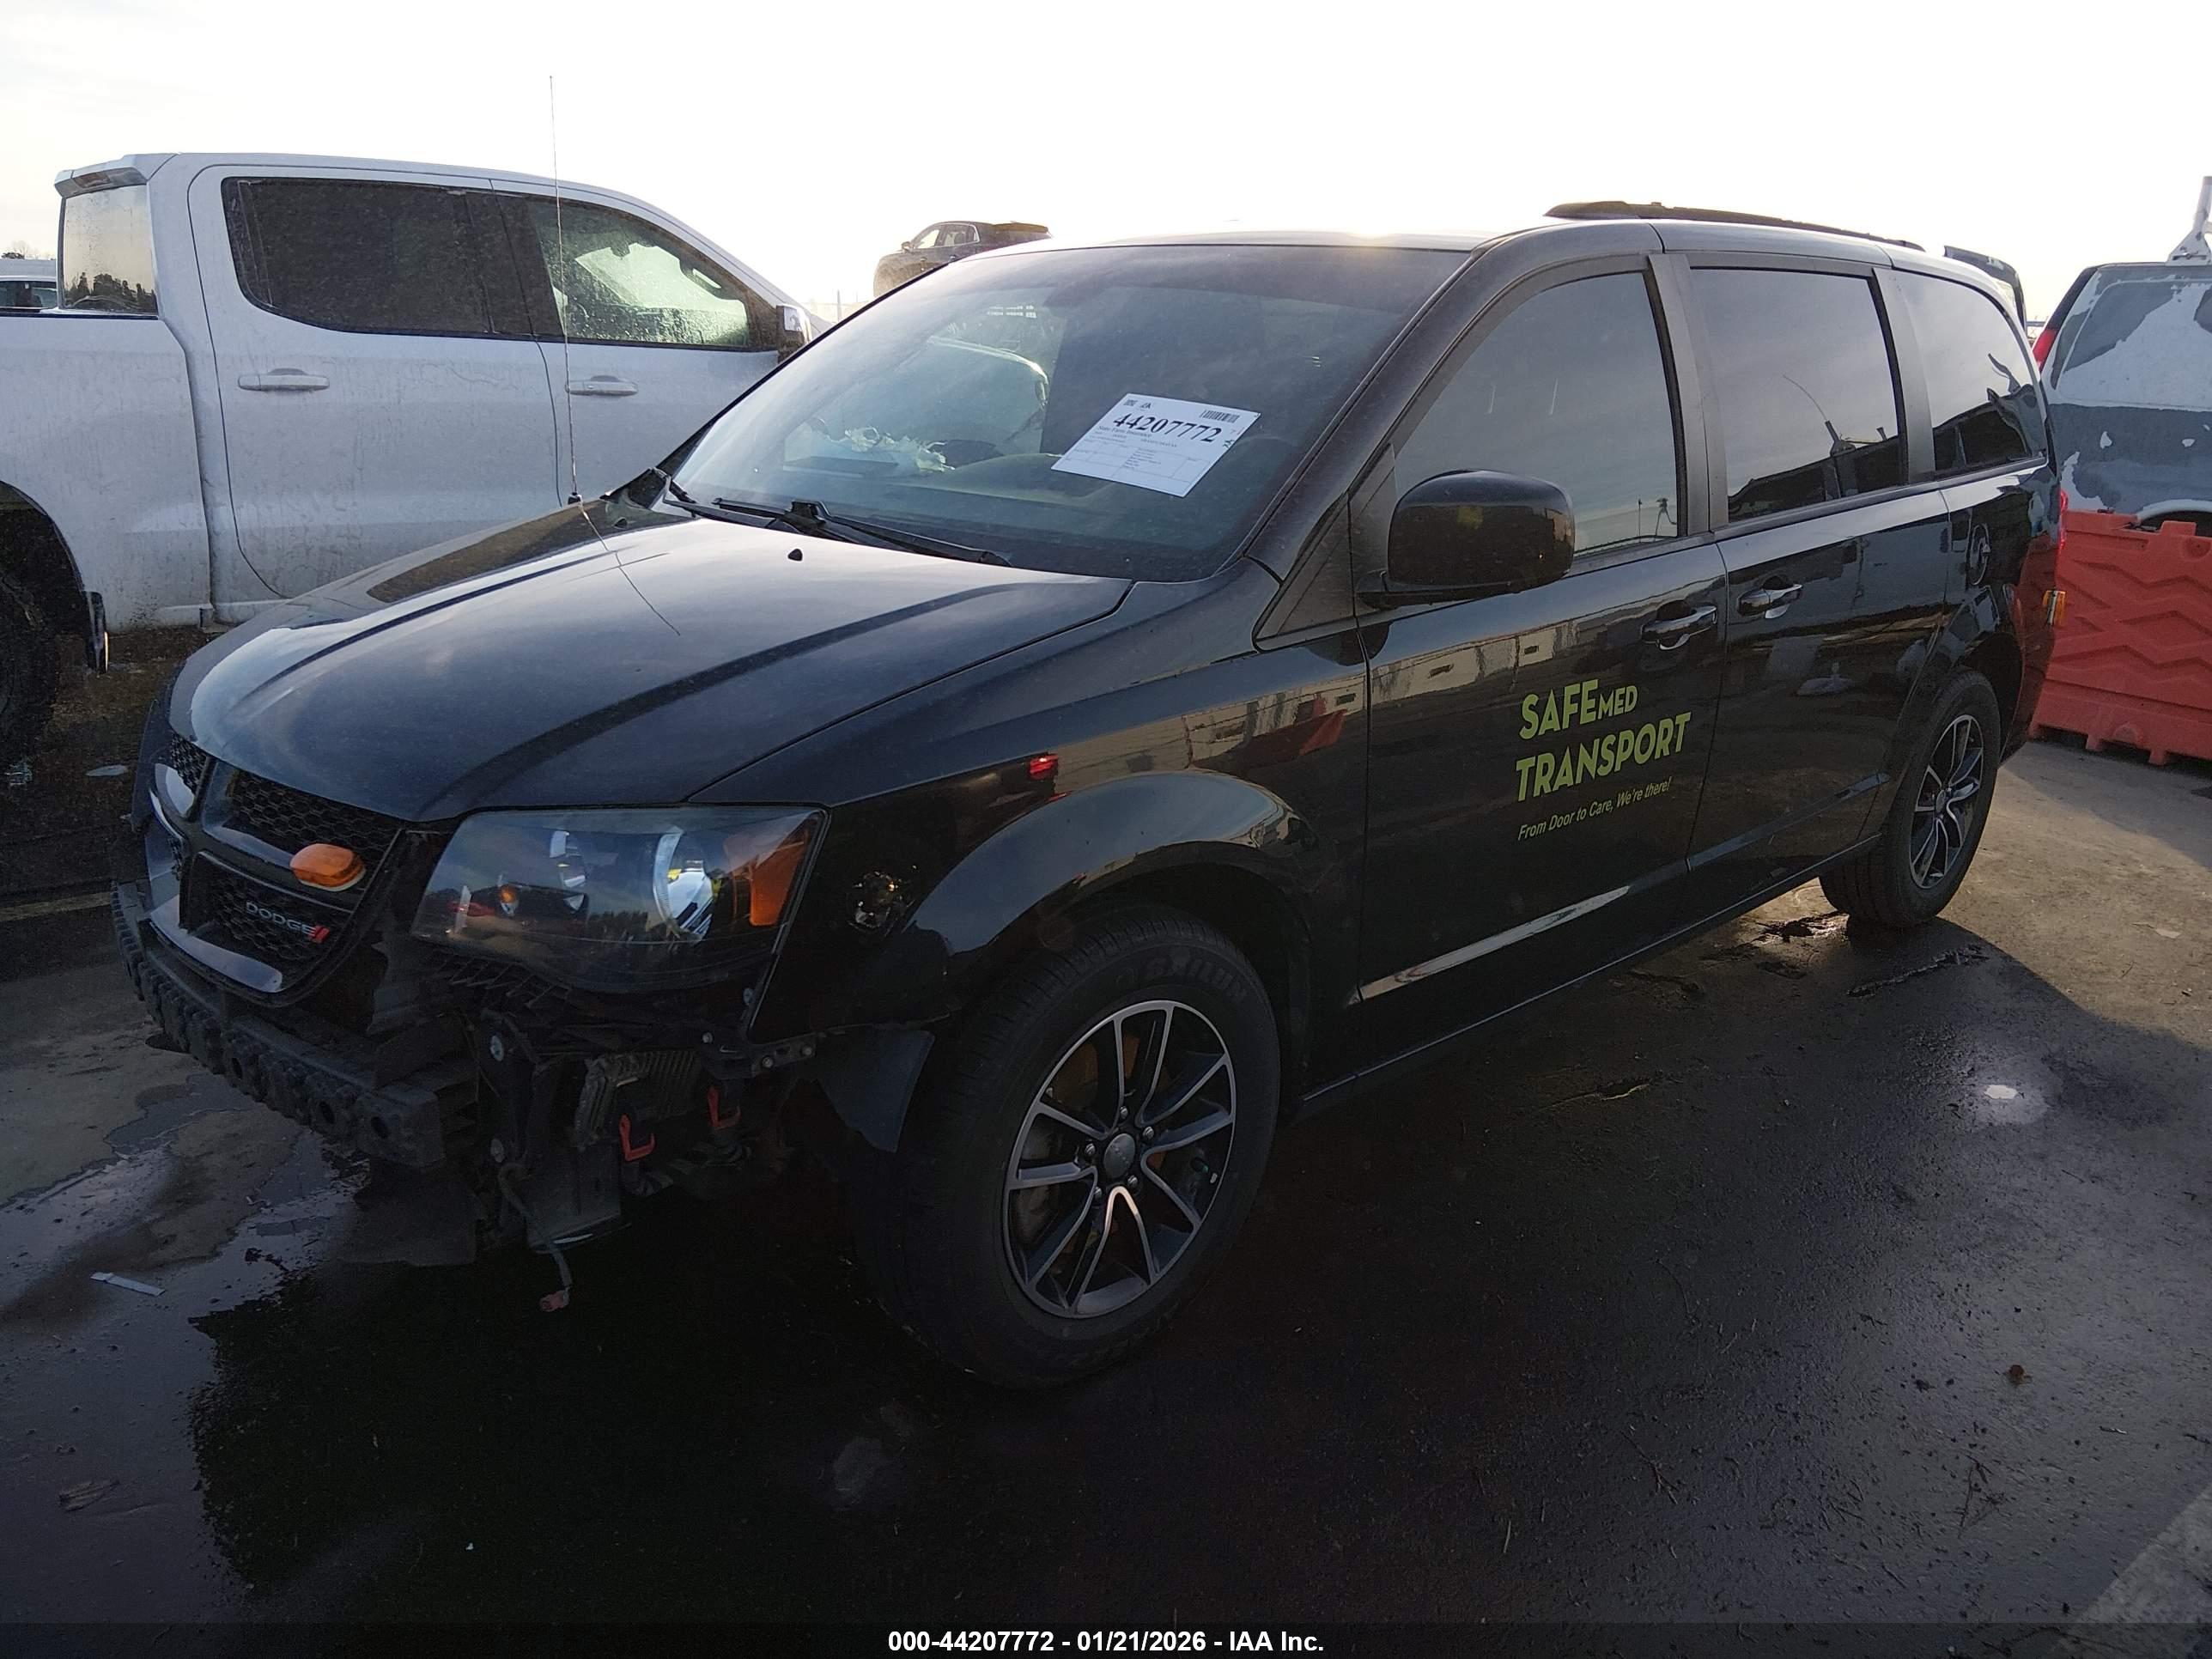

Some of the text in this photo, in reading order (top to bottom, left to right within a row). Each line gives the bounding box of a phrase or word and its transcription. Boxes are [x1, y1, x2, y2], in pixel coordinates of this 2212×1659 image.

[1113, 413, 1222, 443] 44207772
[1516, 712, 1692, 802] TRANSPORT
[1517, 775, 1672, 841] From Door to Care, We're there!
[246, 901, 316, 938] DODGE
